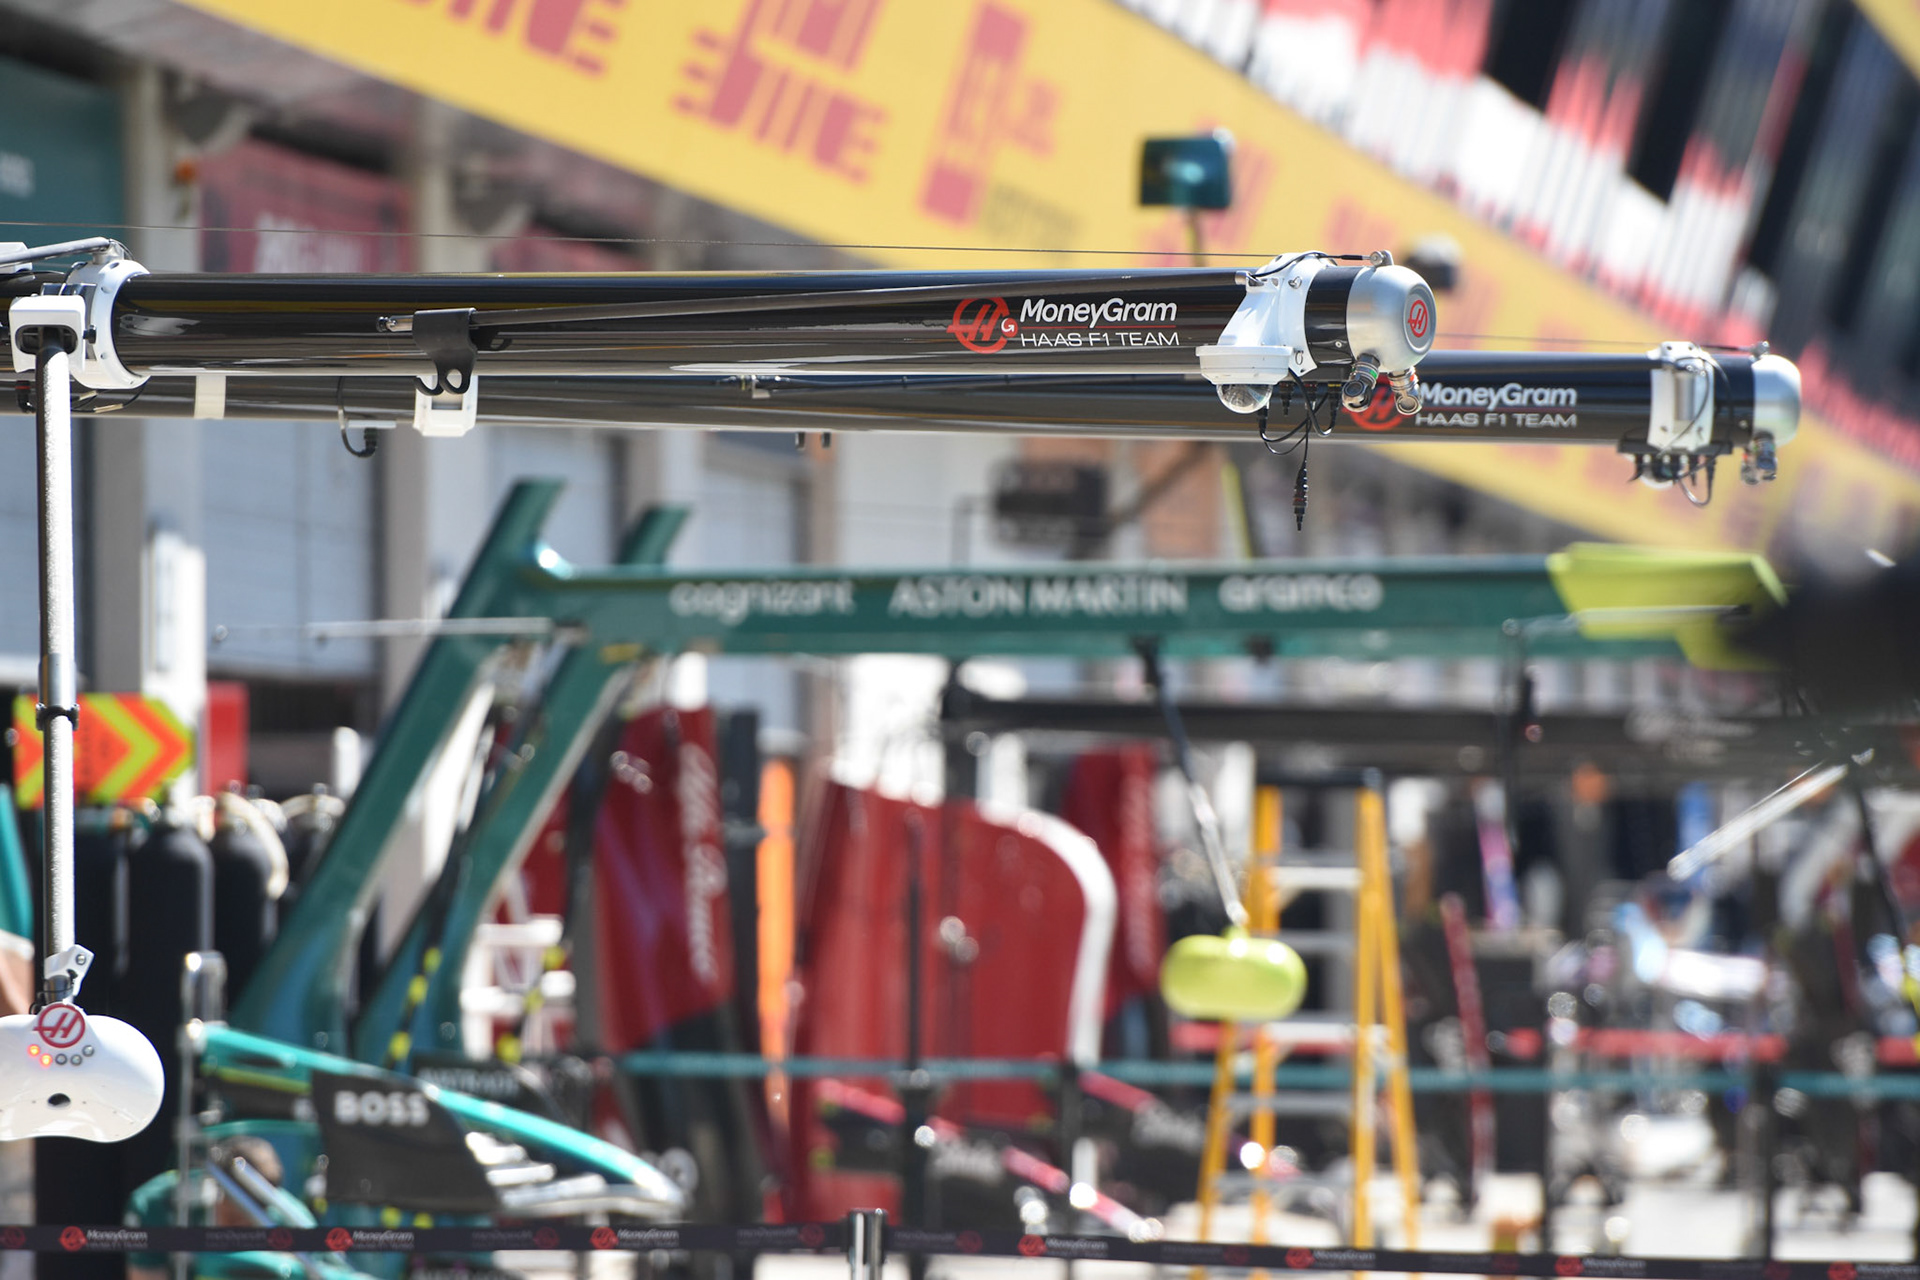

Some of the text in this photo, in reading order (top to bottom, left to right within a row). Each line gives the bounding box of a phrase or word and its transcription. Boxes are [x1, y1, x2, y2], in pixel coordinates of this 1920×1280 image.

[1019, 298, 1178, 329] MoneyGram
[1021, 332, 1180, 347] HAAS F1 TEAM
[1419, 382, 1578, 411] MoneyGram
[1415, 413, 1578, 427] HAAS F1 TEAM
[888, 574, 1026, 619] ASTON
[1028, 574, 1189, 617] MARTIN
[333, 1090, 430, 1127] BOSS
